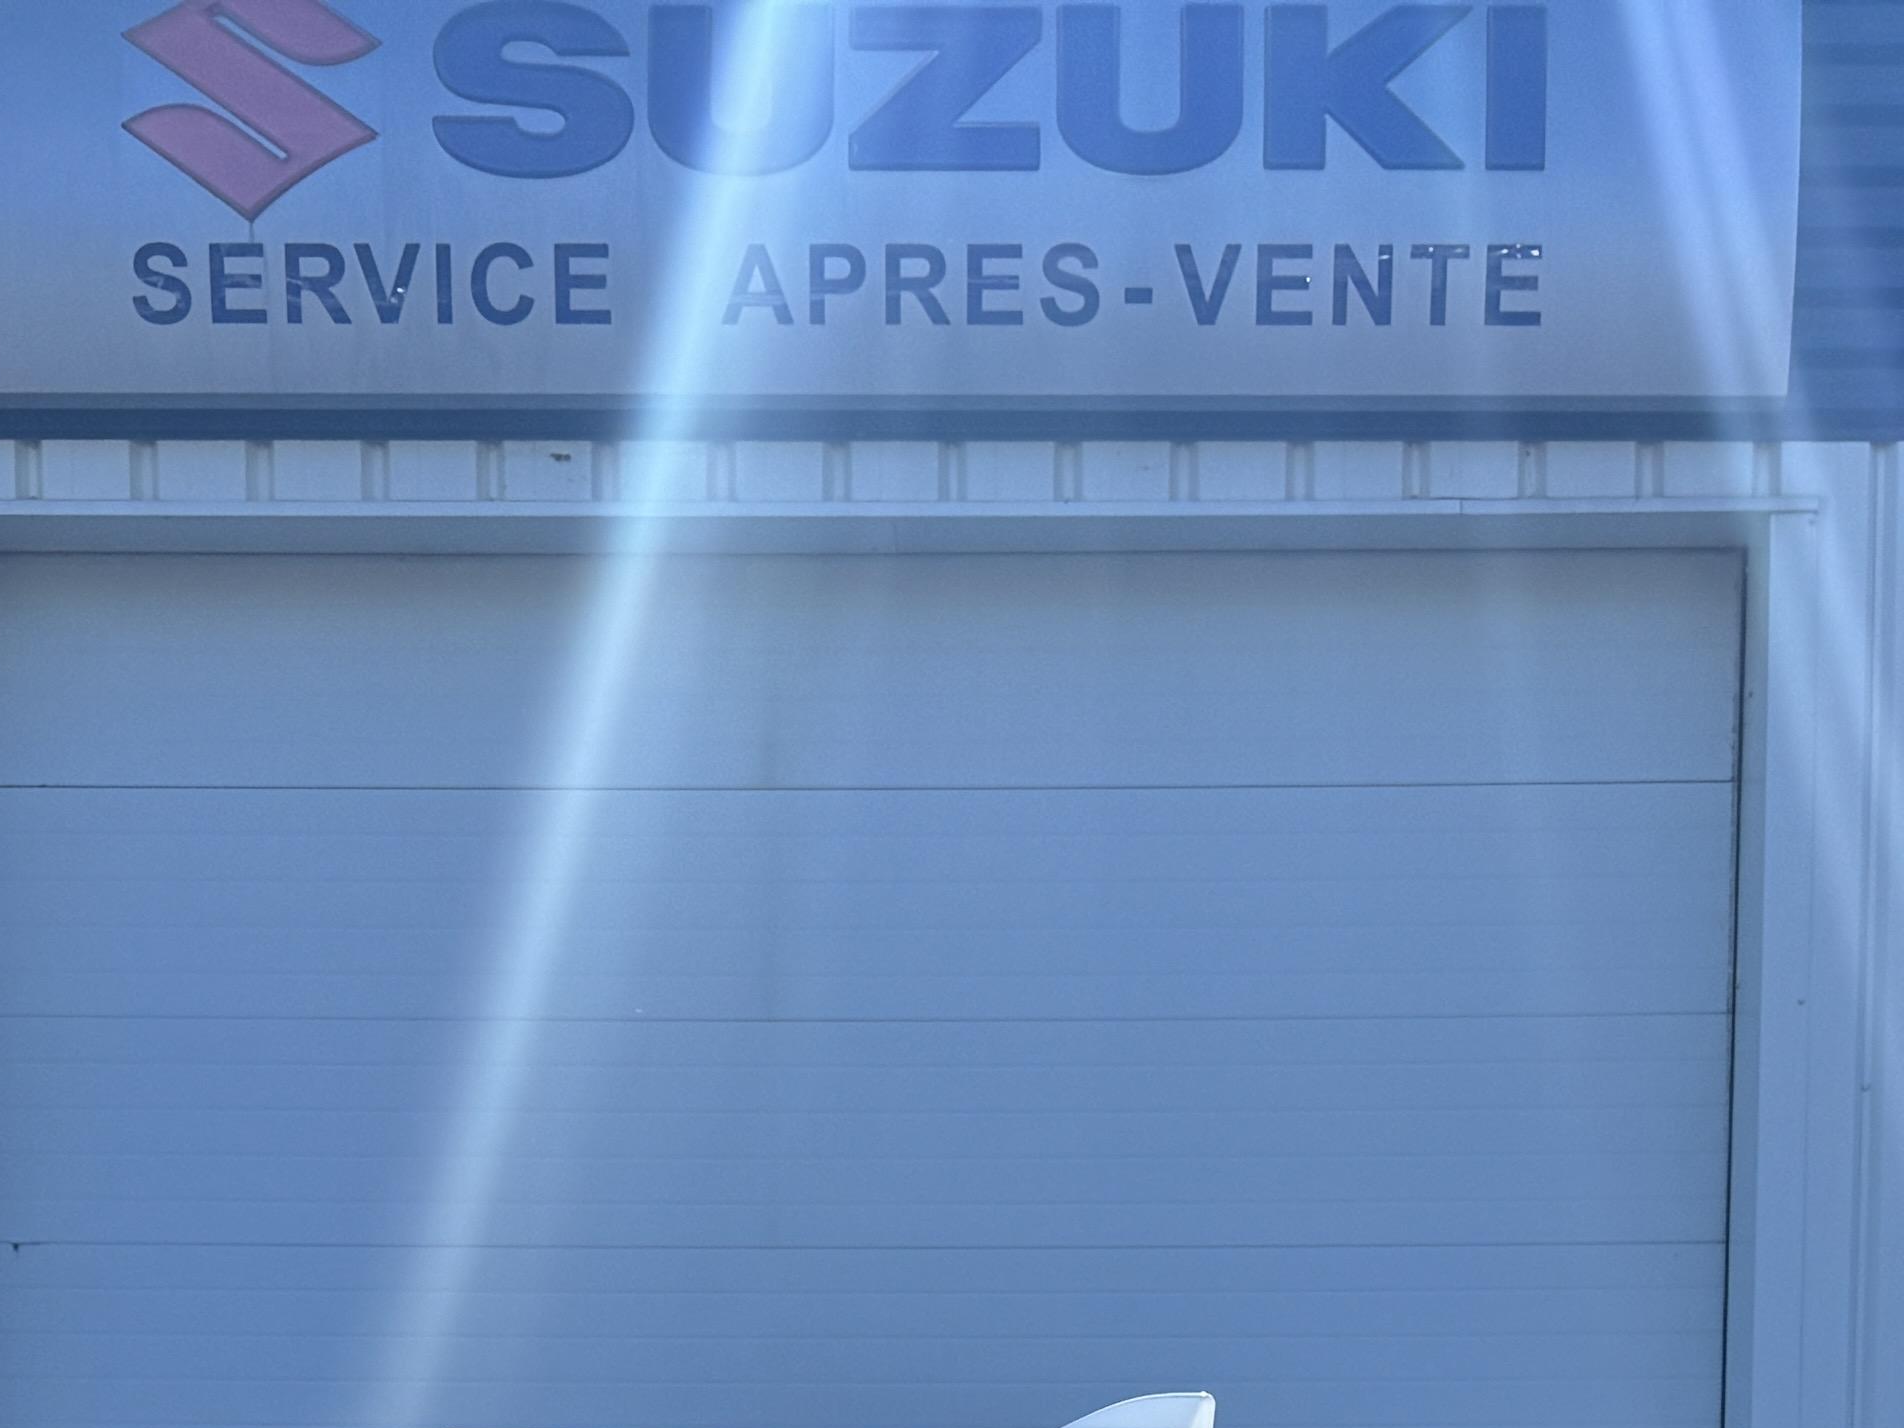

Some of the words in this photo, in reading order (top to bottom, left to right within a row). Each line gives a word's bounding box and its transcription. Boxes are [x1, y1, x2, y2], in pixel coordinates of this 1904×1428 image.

[432, 0, 1546, 178] SUZUKI
[132, 241, 613, 326] SERVICE
[721, 241, 1543, 327] APRES-VENTE
